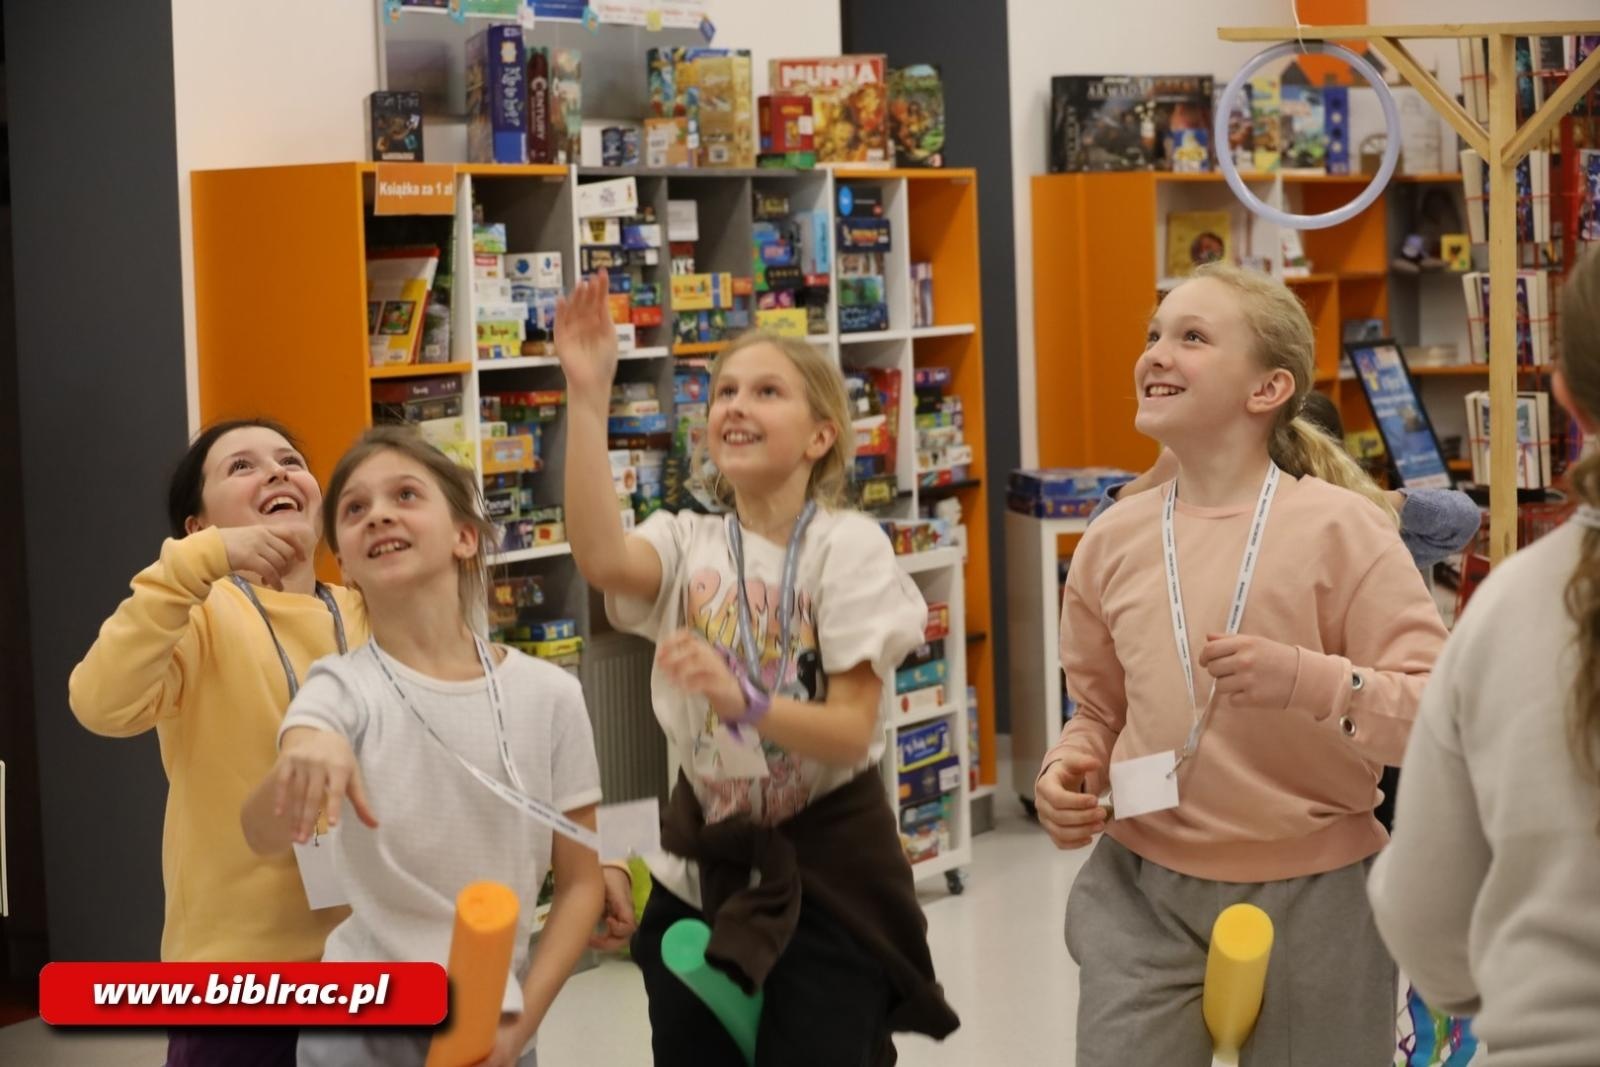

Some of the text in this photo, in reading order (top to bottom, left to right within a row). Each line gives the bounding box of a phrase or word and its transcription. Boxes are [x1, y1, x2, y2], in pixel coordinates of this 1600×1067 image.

[782, 61, 878, 87] MUMIA
[379, 181, 419, 199] Książka
[421, 184, 434, 196] za
[436, 181, 443, 196] 1
